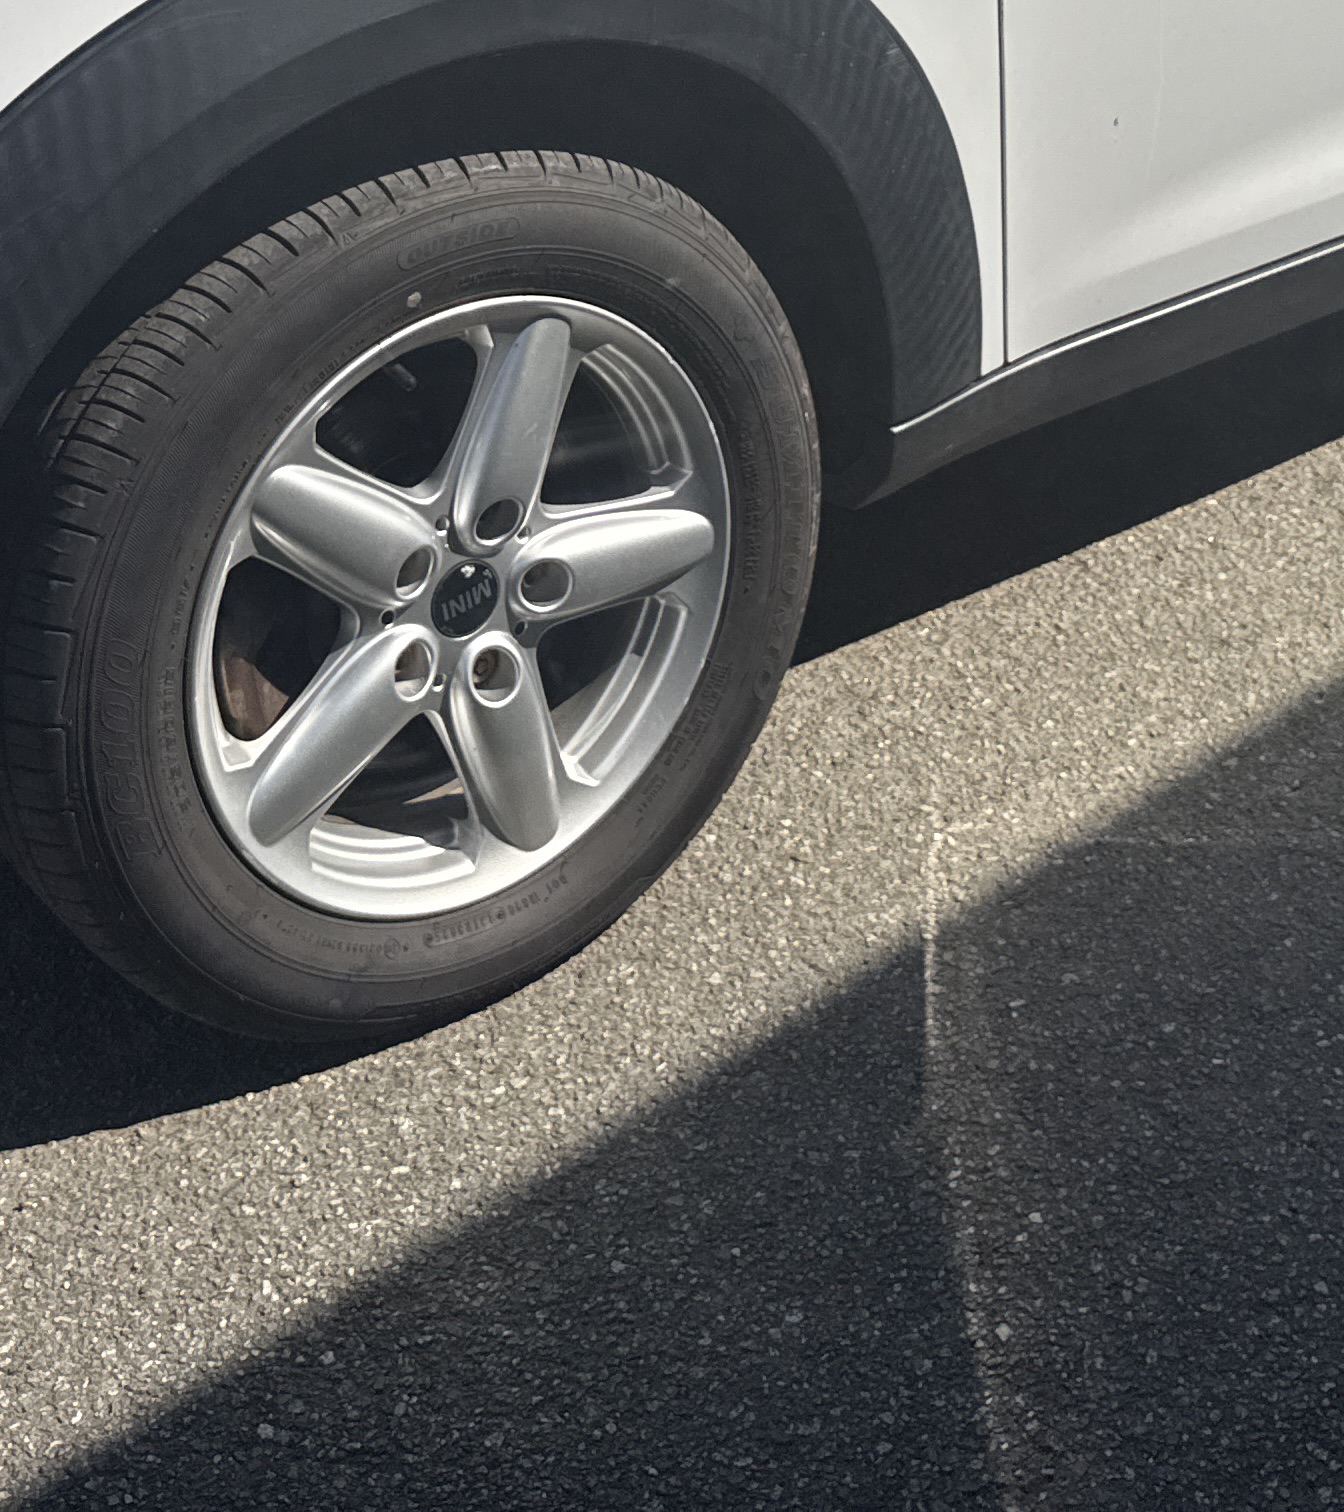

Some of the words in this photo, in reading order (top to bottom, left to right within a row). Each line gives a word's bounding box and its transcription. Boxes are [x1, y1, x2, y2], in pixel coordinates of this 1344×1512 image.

[408, 220, 509, 263] OUTSIDE
[441, 578, 492, 622] MINI
[101, 636, 163, 866] BC100
